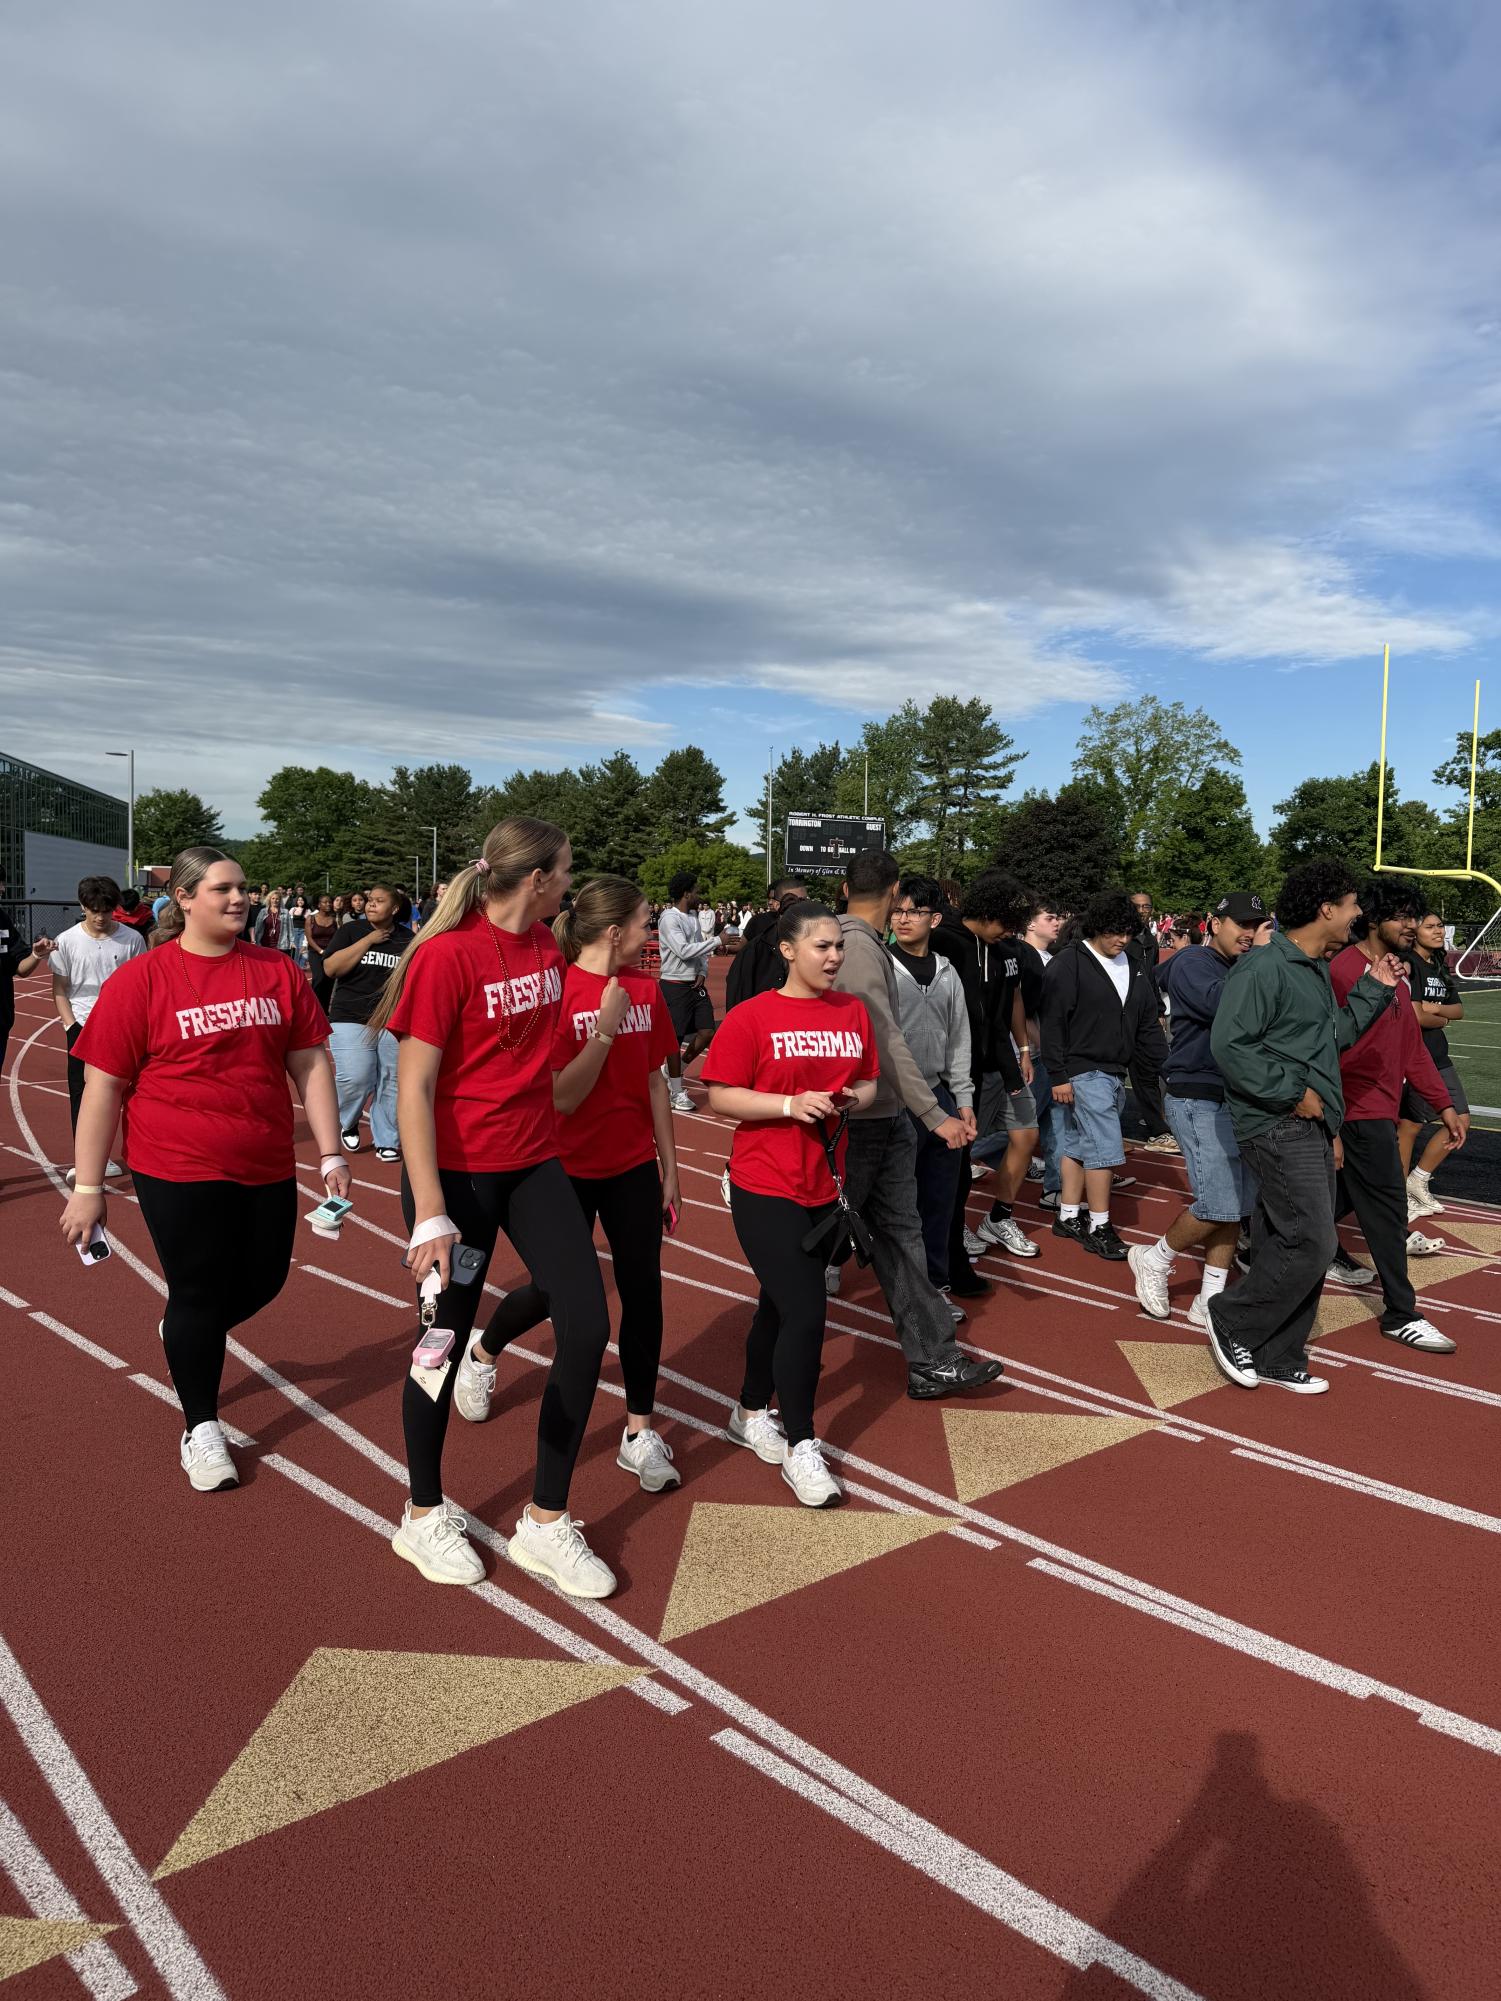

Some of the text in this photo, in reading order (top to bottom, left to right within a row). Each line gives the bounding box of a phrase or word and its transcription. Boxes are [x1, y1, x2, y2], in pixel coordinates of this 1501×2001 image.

[788, 819, 821, 827] TORRINGTON
[866, 823, 882, 831] GUEST
[795, 867, 814, 875] Memory
[1436, 987, 1447, 997] LAT
[176, 997, 282, 1040] FRESHMAN
[572, 1003, 652, 1041] FRMAN
[770, 1030, 863, 1060] FRESHMAN
